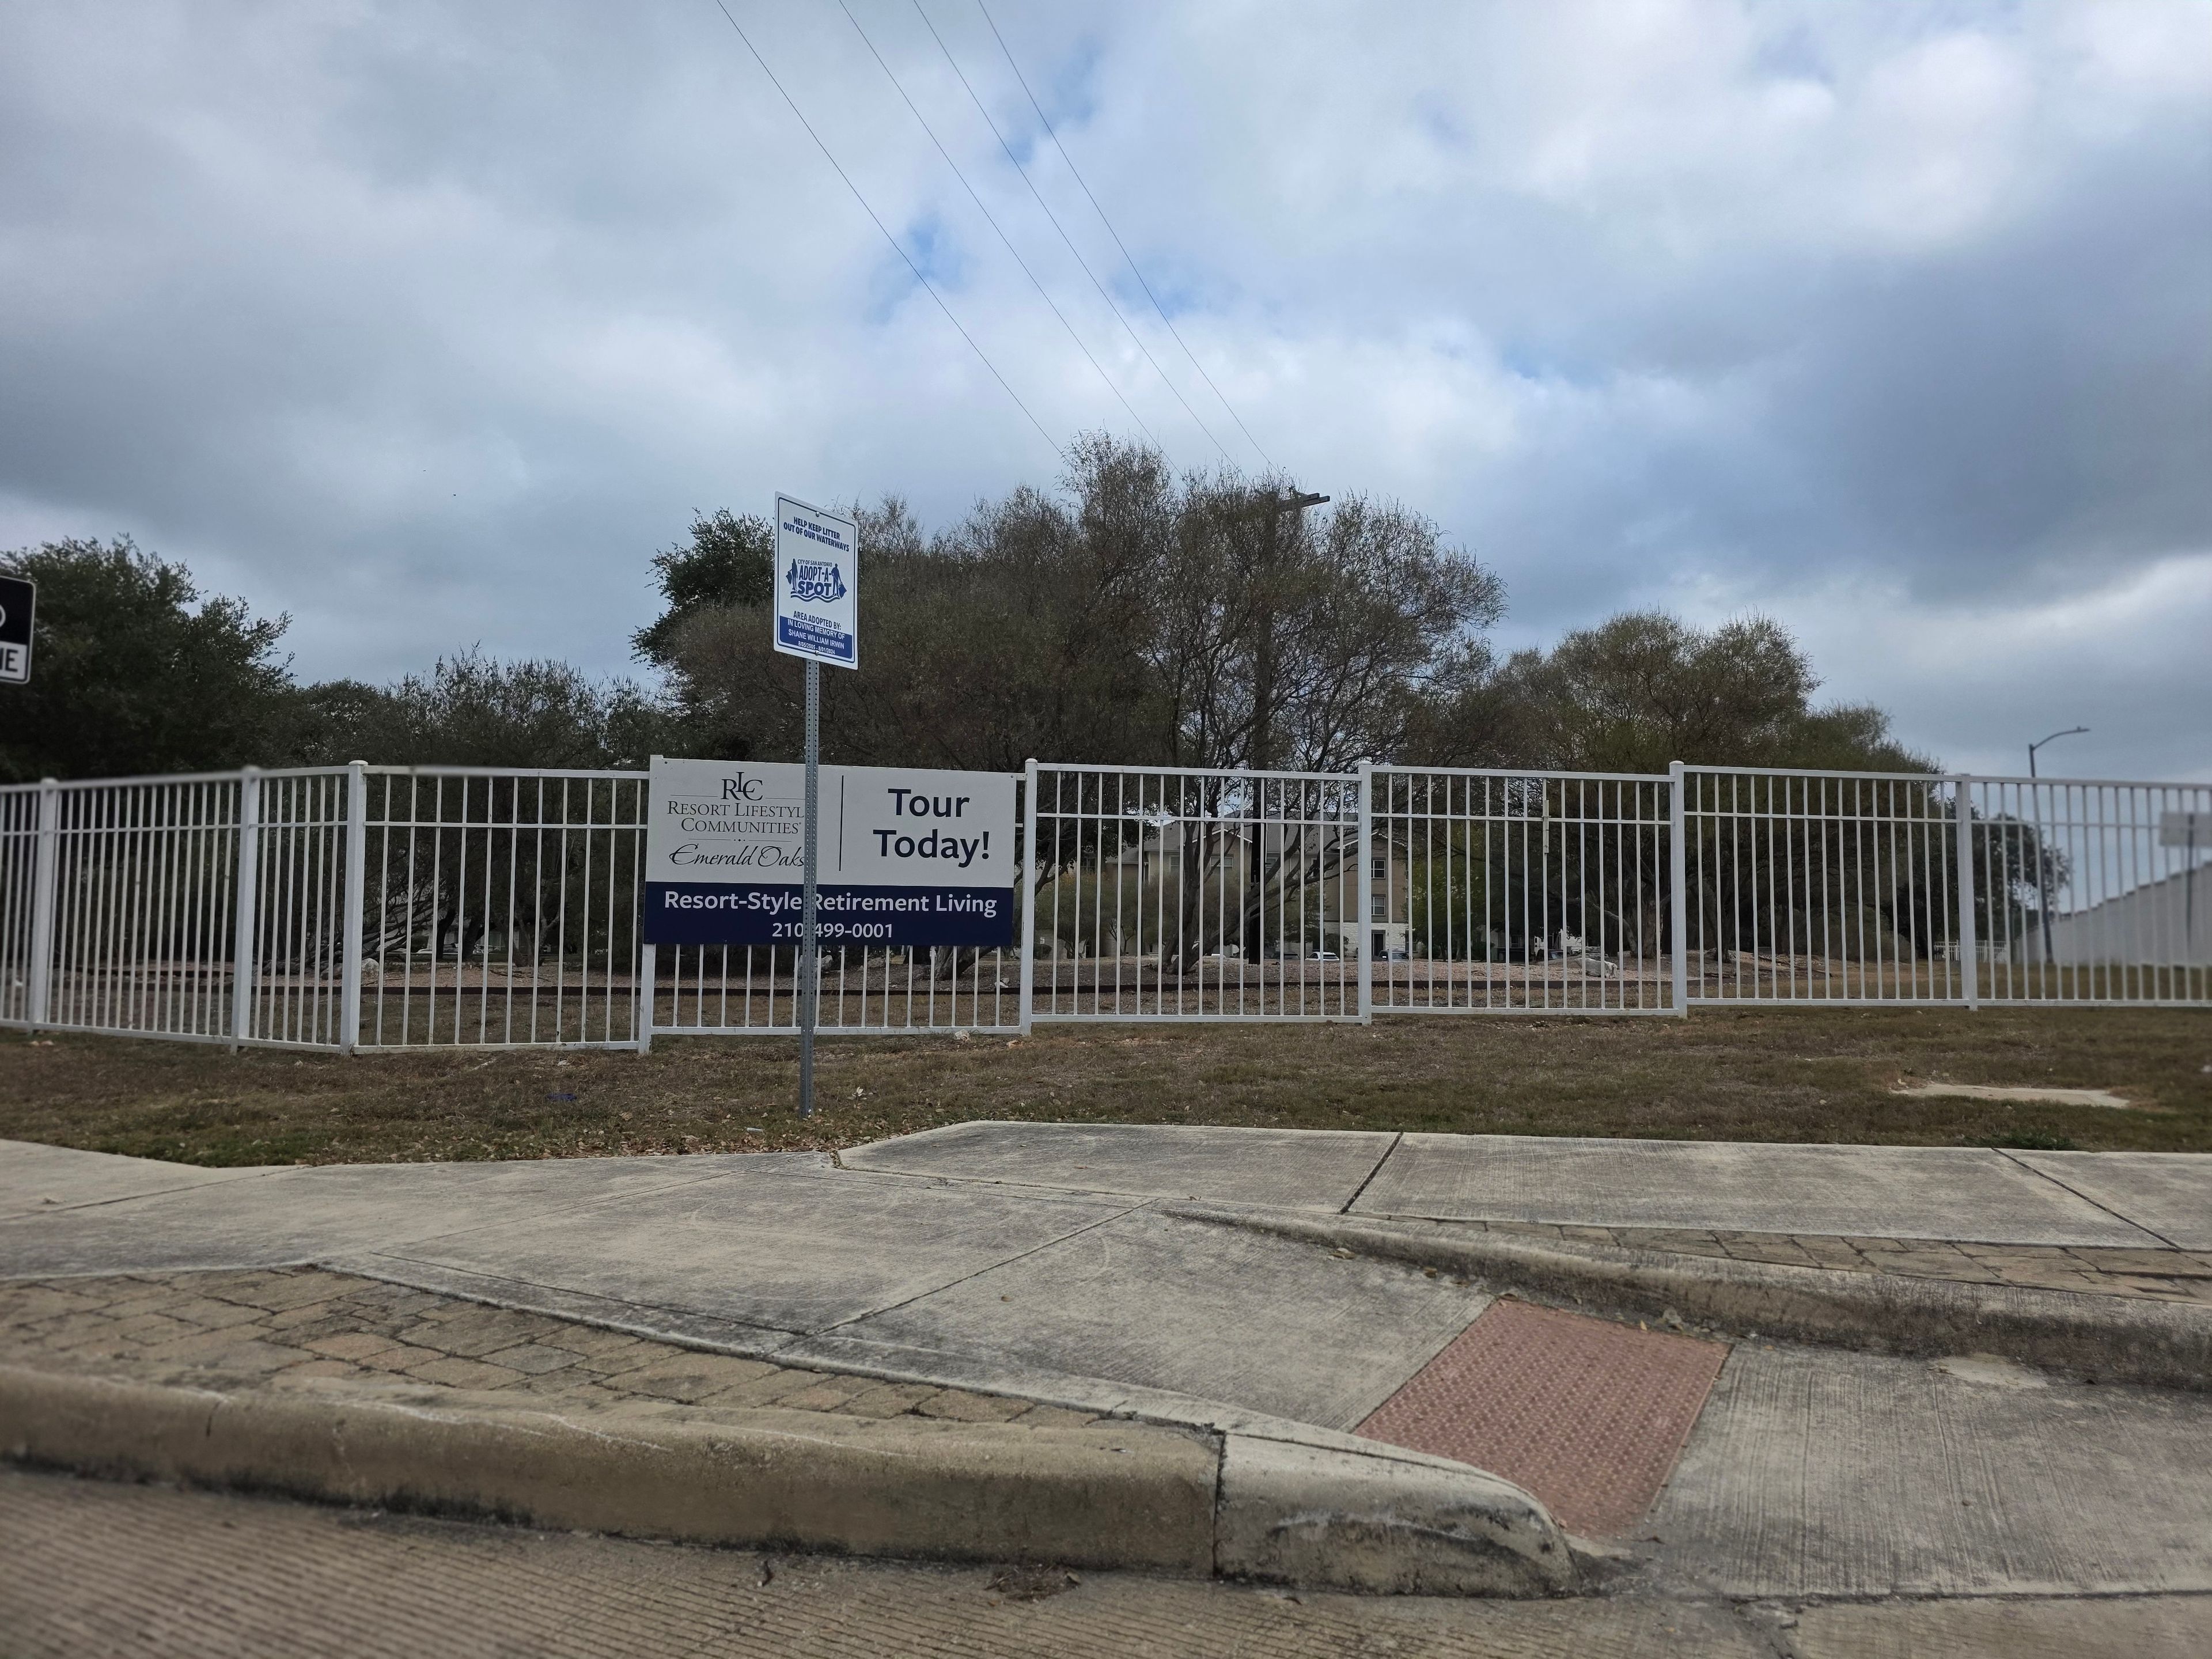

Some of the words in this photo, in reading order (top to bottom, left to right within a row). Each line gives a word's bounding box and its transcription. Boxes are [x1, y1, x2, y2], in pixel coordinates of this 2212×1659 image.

[783, 522, 795, 533] OUT
[796, 527, 803, 535] OF
[804, 529, 815, 540] OUR
[816, 533, 850, 552] WATERWAYS
[793, 517, 808, 528] HELP
[808, 522, 822, 533] KEEP
[823, 527, 840, 540] LITTER
[797, 581, 832, 596] SPOT
[793, 611, 808, 622] AREA
[808, 615, 832, 628] ADOPTED
[794, 620, 814, 631] LOVING
[815, 626, 837, 639] MEMORY
[788, 628, 806, 639] SHANE
[808, 633, 829, 646] WILLIAM
[830, 639, 844, 649] IRWIN
[667, 801, 730, 817] RESORT
[734, 802, 805, 818] LIFESTYL
[888, 788, 970, 817] Tour
[669, 843, 759, 866] Emerald
[757, 845, 805, 867] Oaks
[873, 828, 990, 868] Today!
[664, 891, 802, 915] Resort-Style
[815, 892, 929, 911] Retirement
[935, 893, 997, 918] Living
